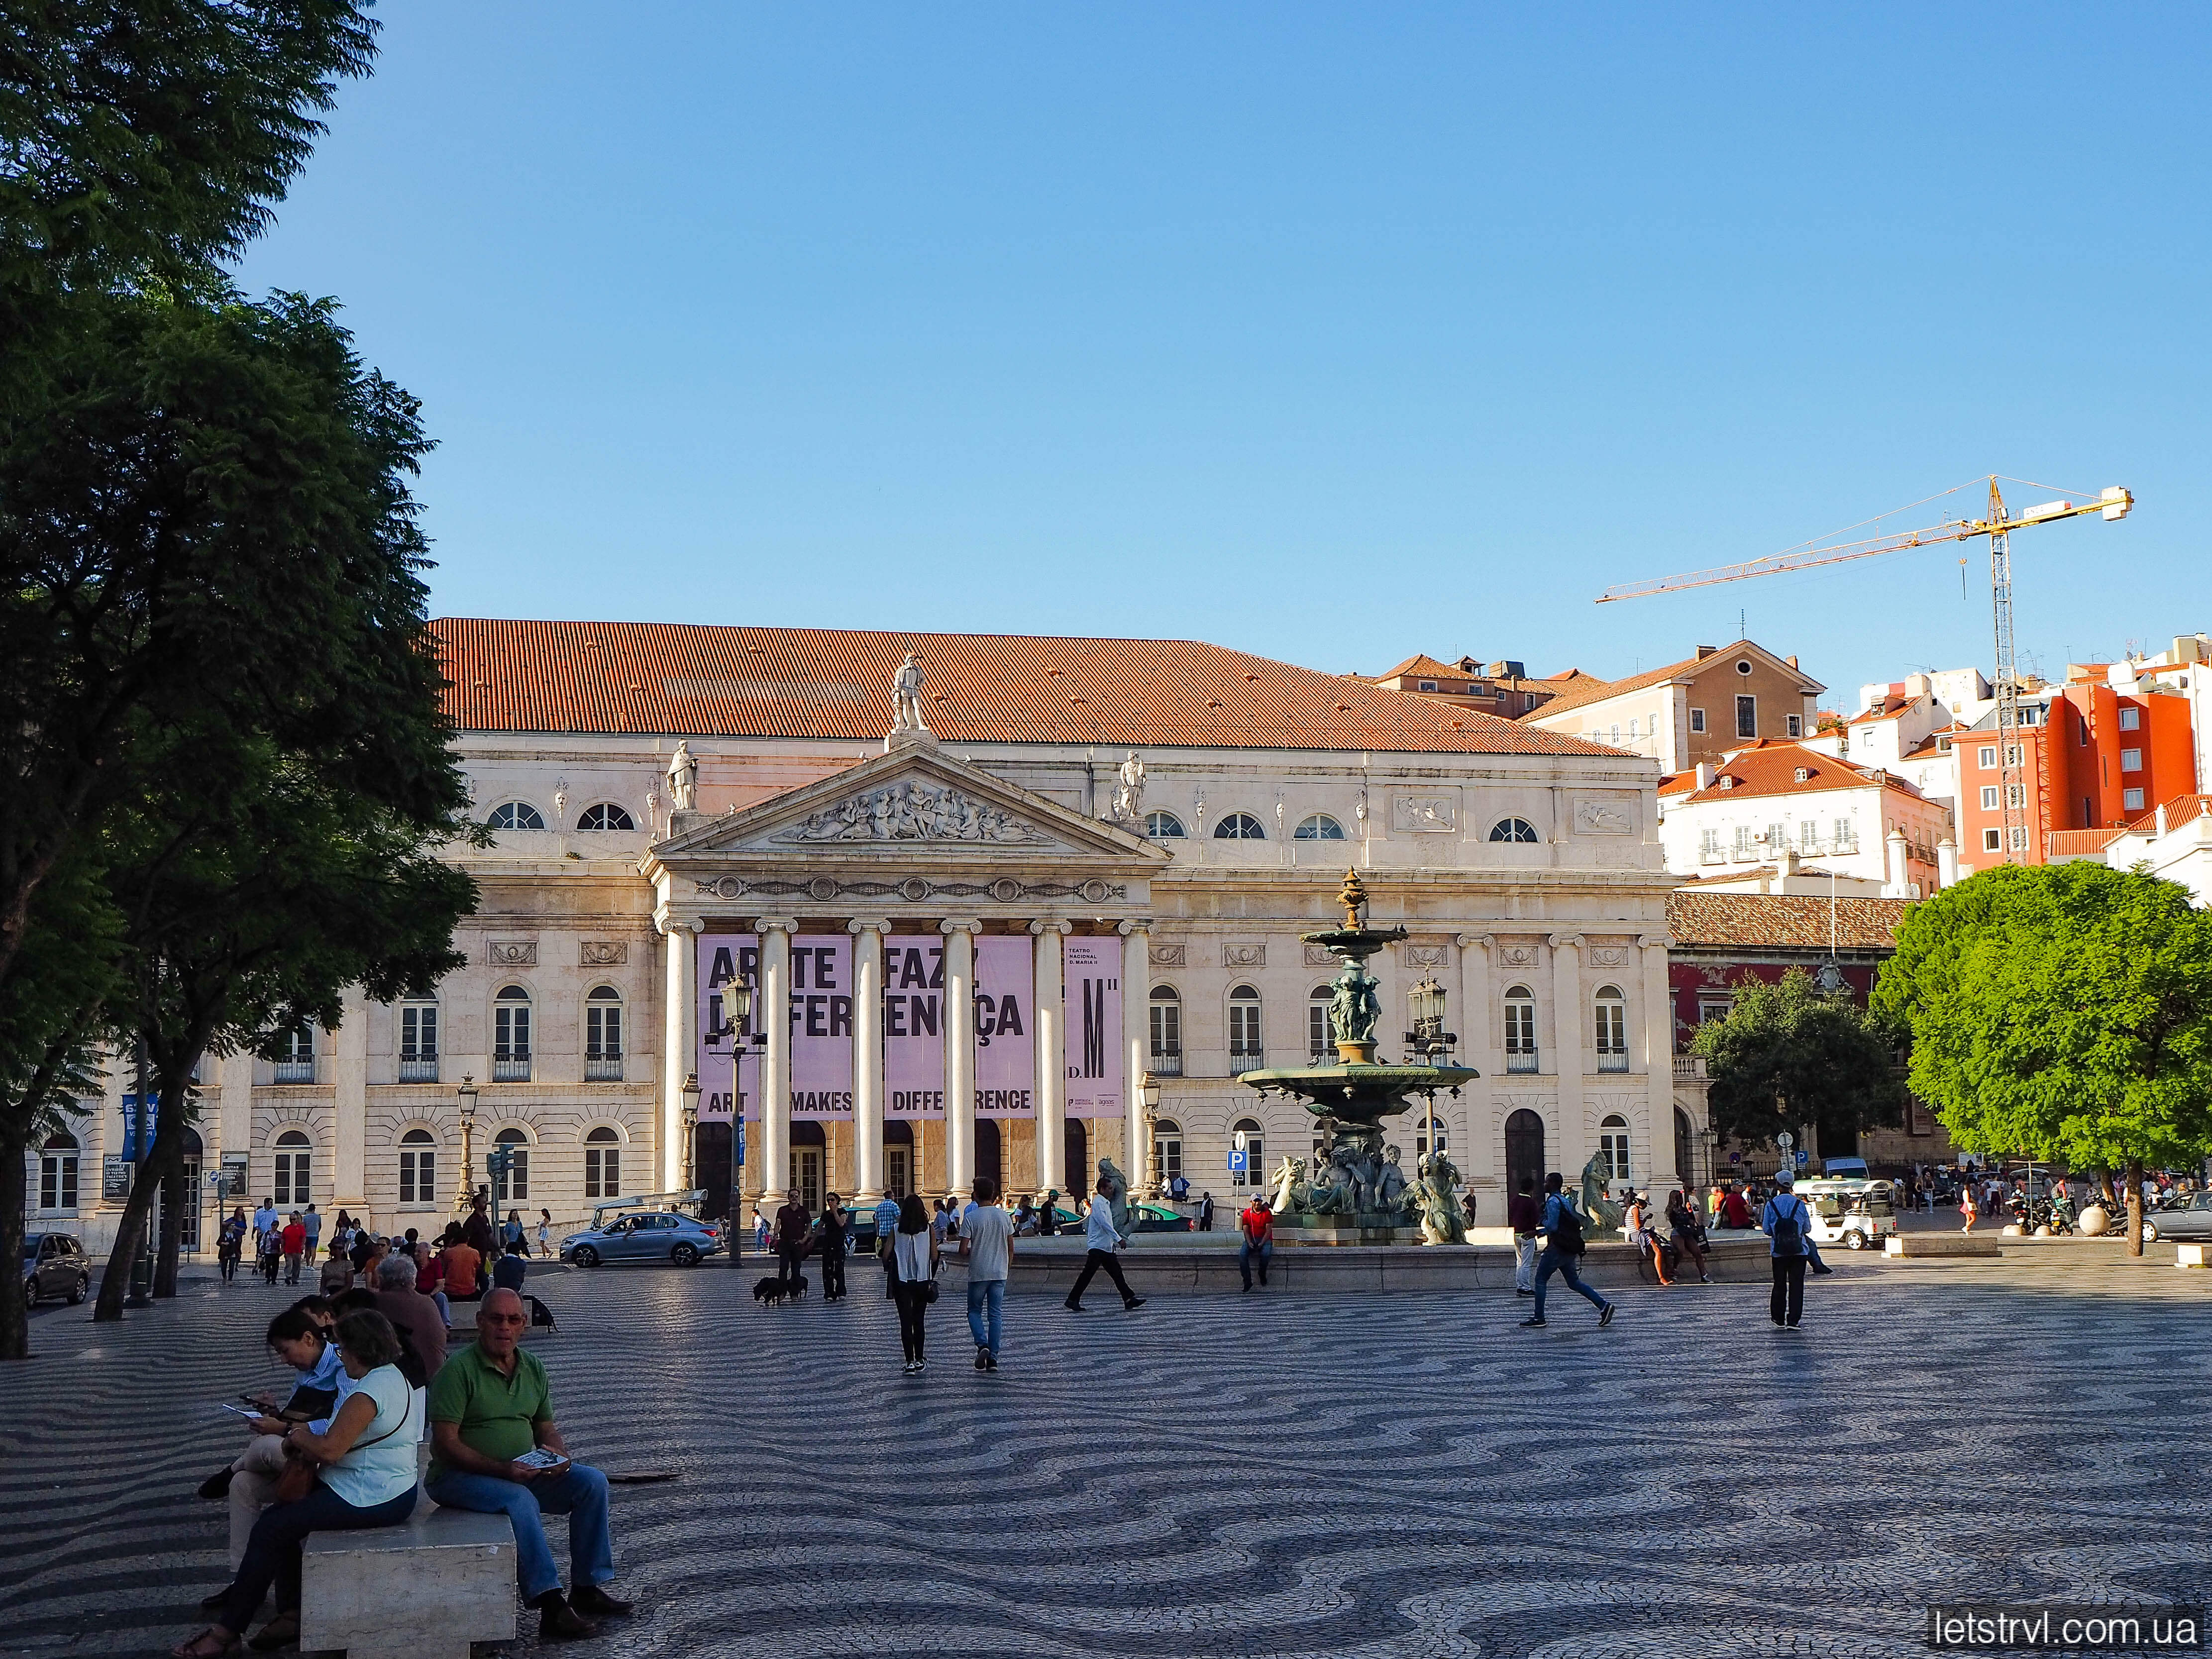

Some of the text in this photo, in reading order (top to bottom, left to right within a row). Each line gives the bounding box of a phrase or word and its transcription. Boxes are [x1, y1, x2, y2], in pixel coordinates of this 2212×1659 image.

[708, 1092, 748, 1112] ART
[791, 1092, 852, 1112] MAKES
[1231, 1152, 1243, 1169] P
[1797, 1152, 1805, 1162] P
